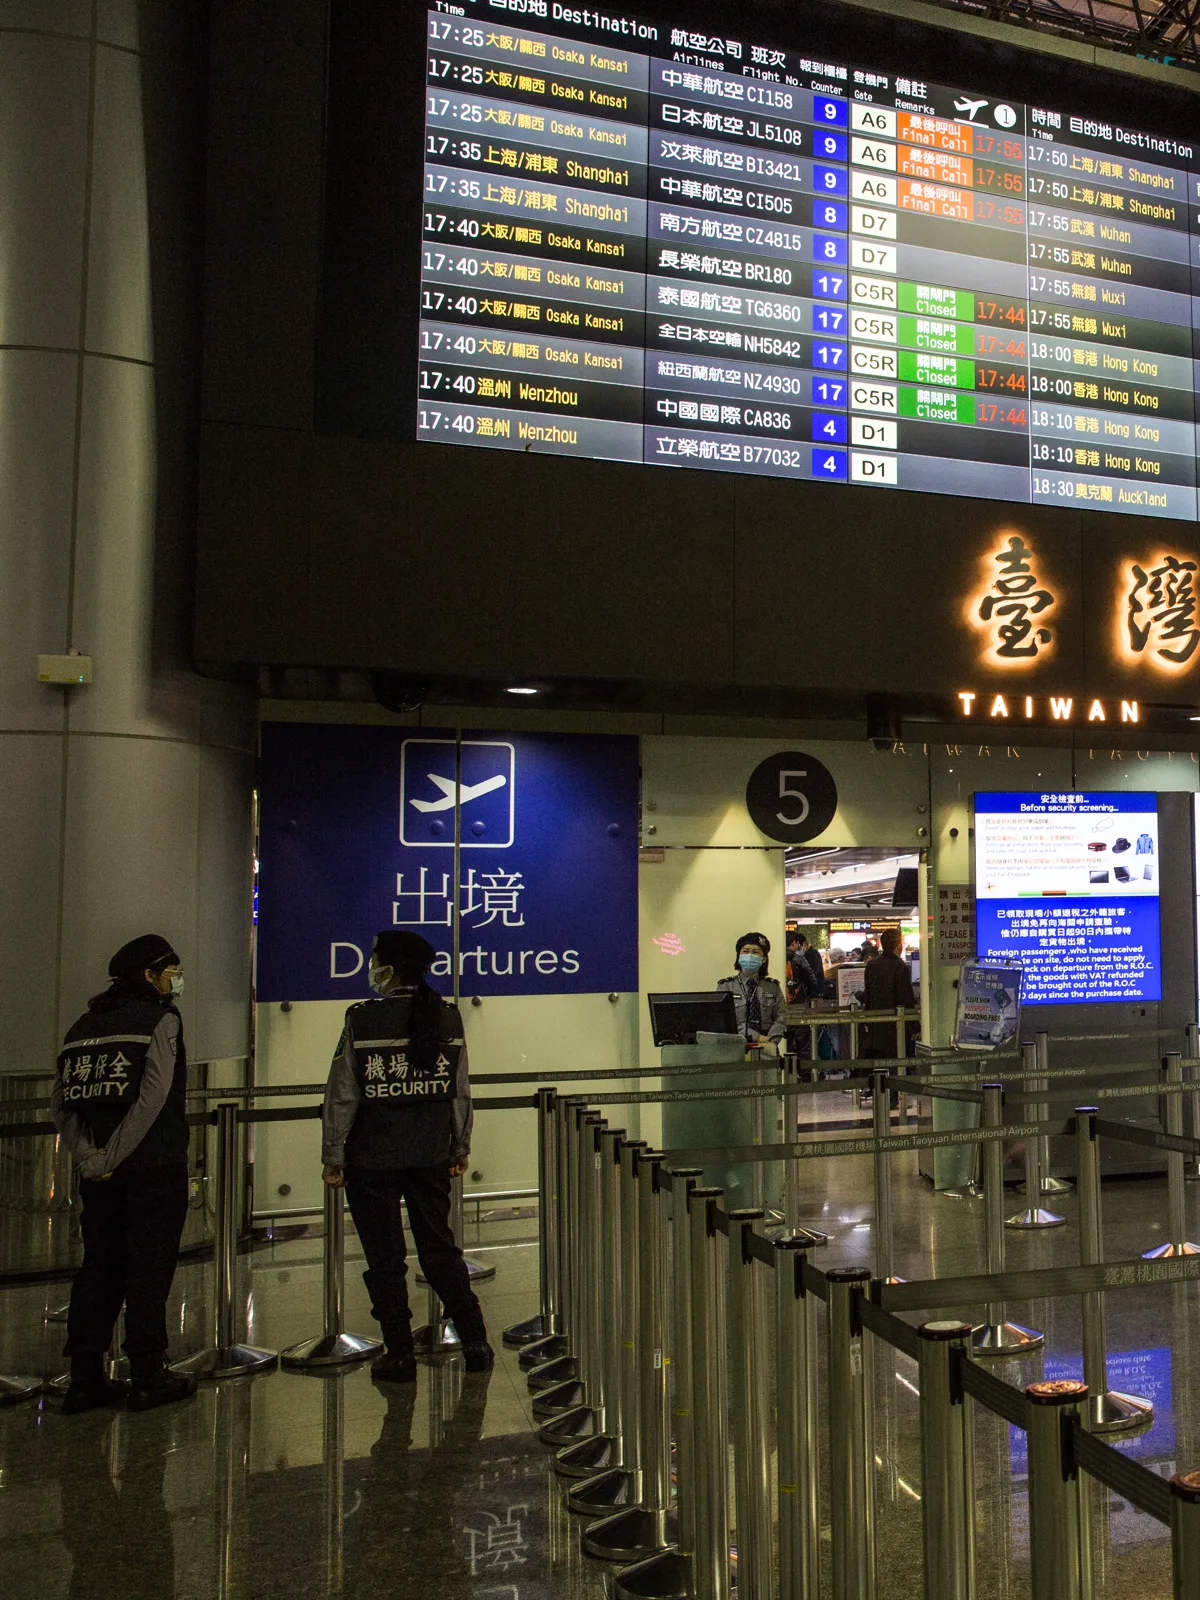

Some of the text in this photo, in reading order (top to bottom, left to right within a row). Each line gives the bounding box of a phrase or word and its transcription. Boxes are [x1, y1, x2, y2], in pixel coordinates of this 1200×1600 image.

[552, 1, 657, 41] Destination
[670, 27, 785, 69] 航空公司 班次
[673, 50, 802, 87] Airlines Flight No.
[428, 20, 1021, 160] 17:25 大阪/關西 Osaka Kansai 中華航空 CI158 9 A6 17:55
[909, 114, 961, 138] 最後呼叫
[902, 127, 967, 151] Final Call
[426, 134, 887, 231] 17:35 上海/浦東 Shanghai 中華航空 CI505 8 D7
[1029, 210, 1069, 231] 17:55
[1070, 218, 1095, 237] 武漢
[1100, 225, 1130, 243] Wuhan
[1032, 410, 1072, 429] 18:10
[1073, 415, 1099, 434] 香港
[1104, 420, 1129, 438] Hong
[1134, 424, 1159, 442] Kong
[417, 410, 886, 477] 17:40 溫州 Wenzhou 立榮航空 B77032 4 D1
[959, 693, 1139, 724] TAIWAN
[776, 770, 809, 825] 5
[1048, 804, 1076, 812] security
[392, 867, 525, 928] 出境
[941, 930, 967, 938] PLEASE
[330, 942, 580, 980] Dartures
[988, 949, 1019, 957] Foreign
[1021, 948, 1066, 956] passengers
[1123, 954, 1145, 963] apply
[1043, 973, 1068, 982] goods
[1053, 964, 1093, 973] departure
[1028, 992, 1046, 1000] days
[1086, 990, 1122, 999] purchase
[1039, 982, 1071, 991] brought
[976, 1073, 998, 1081] Taiwan
[1000, 1072, 1024, 1081] Taoyuan
[1025, 1070, 1063, 1079] International
[1064, 1068, 1086, 1077] Airport
[63, 1082, 129, 1102] ECURITY
[365, 1080, 450, 1097] SECURITY
[649, 1087, 775, 1100] Taiwan Taoyuan International Airport
